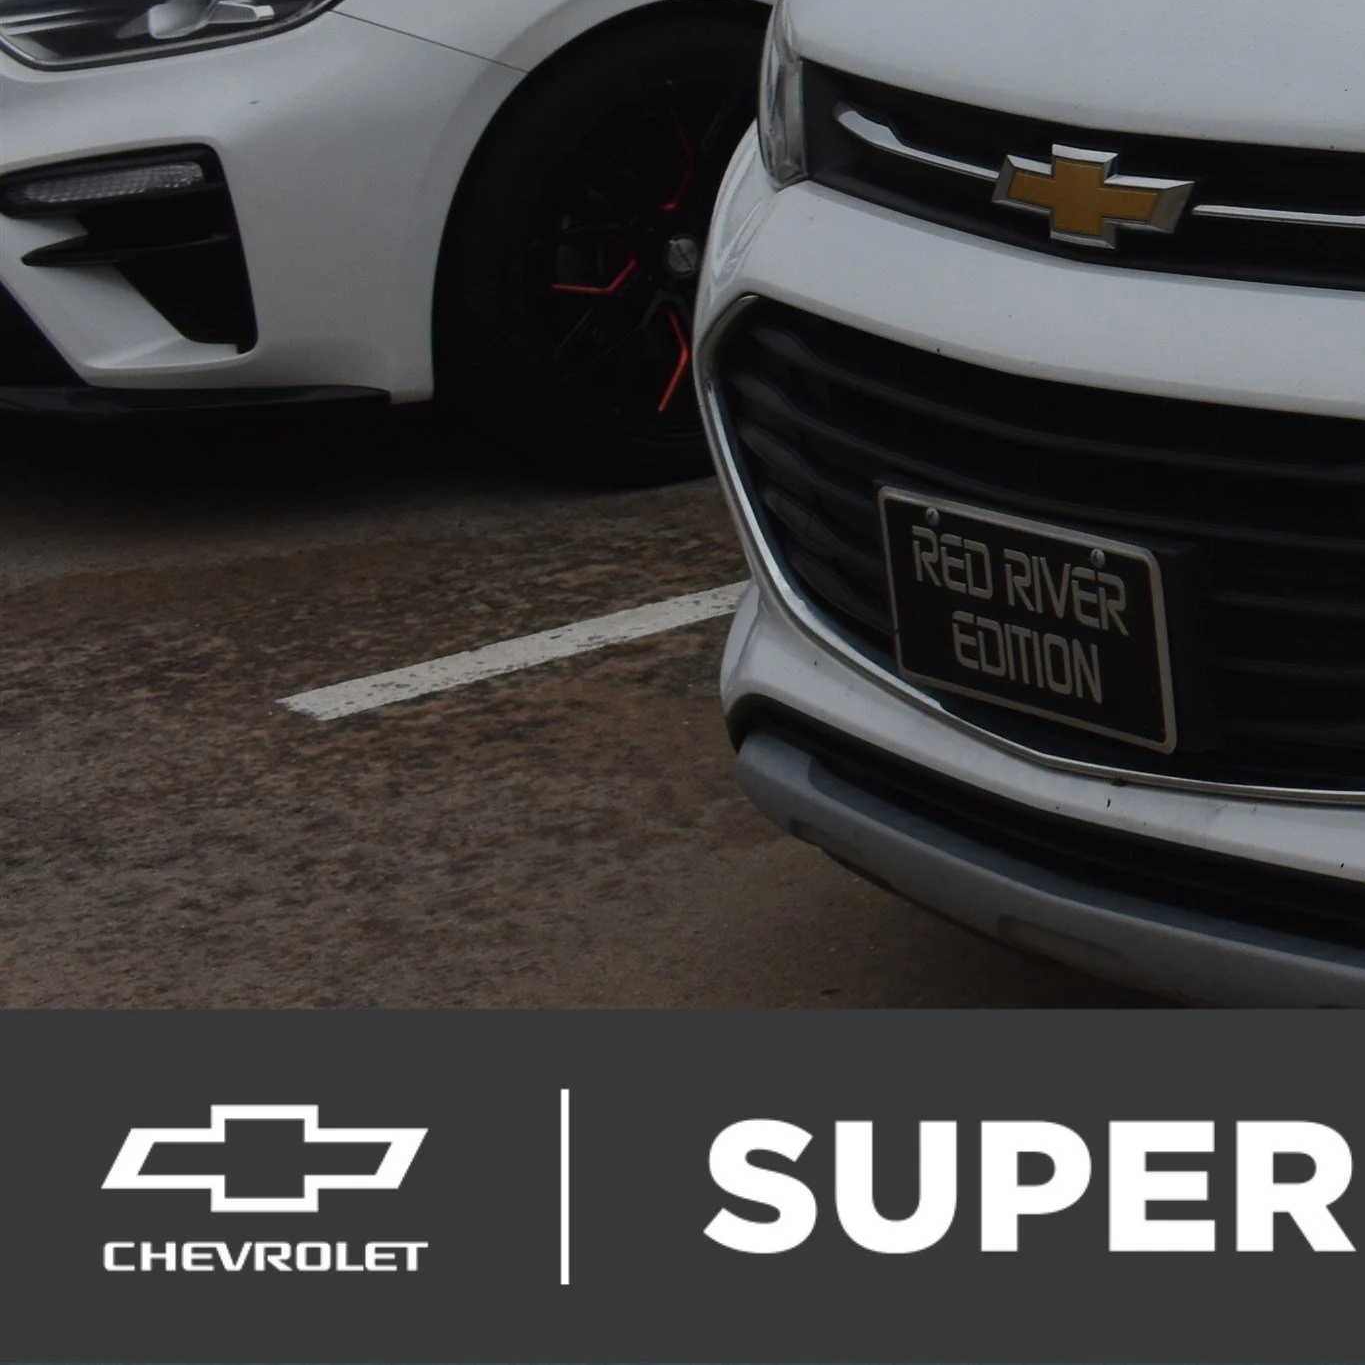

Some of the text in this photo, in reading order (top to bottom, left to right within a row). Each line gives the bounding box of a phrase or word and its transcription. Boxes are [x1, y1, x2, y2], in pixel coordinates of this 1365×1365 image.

[912, 525, 1130, 638] RED RIVER
[952, 610, 1103, 705] EDITION
